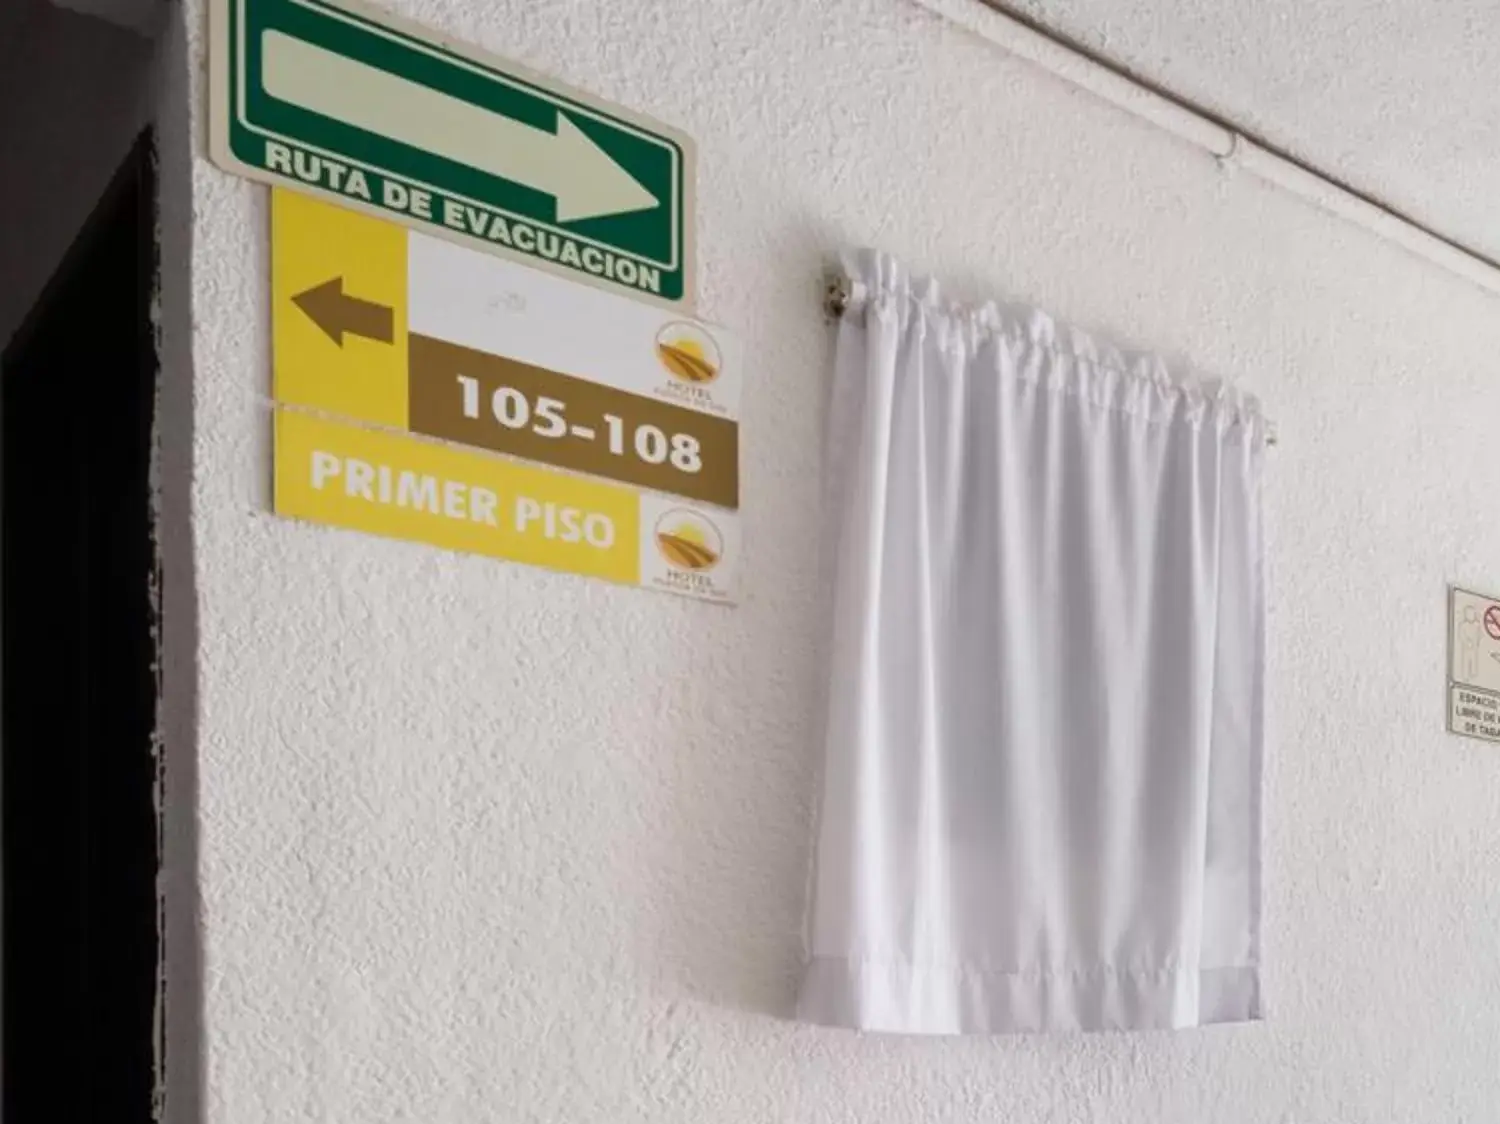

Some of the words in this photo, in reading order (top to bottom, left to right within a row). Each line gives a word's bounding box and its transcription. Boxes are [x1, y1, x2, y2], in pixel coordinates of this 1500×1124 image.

[264, 139, 371, 200] RUTA
[383, 178, 433, 220] DE
[444, 200, 661, 293] EVACUACION
[455, 373, 703, 473] 105-108
[310, 449, 498, 528] PRIMER
[514, 494, 616, 550] PISO
